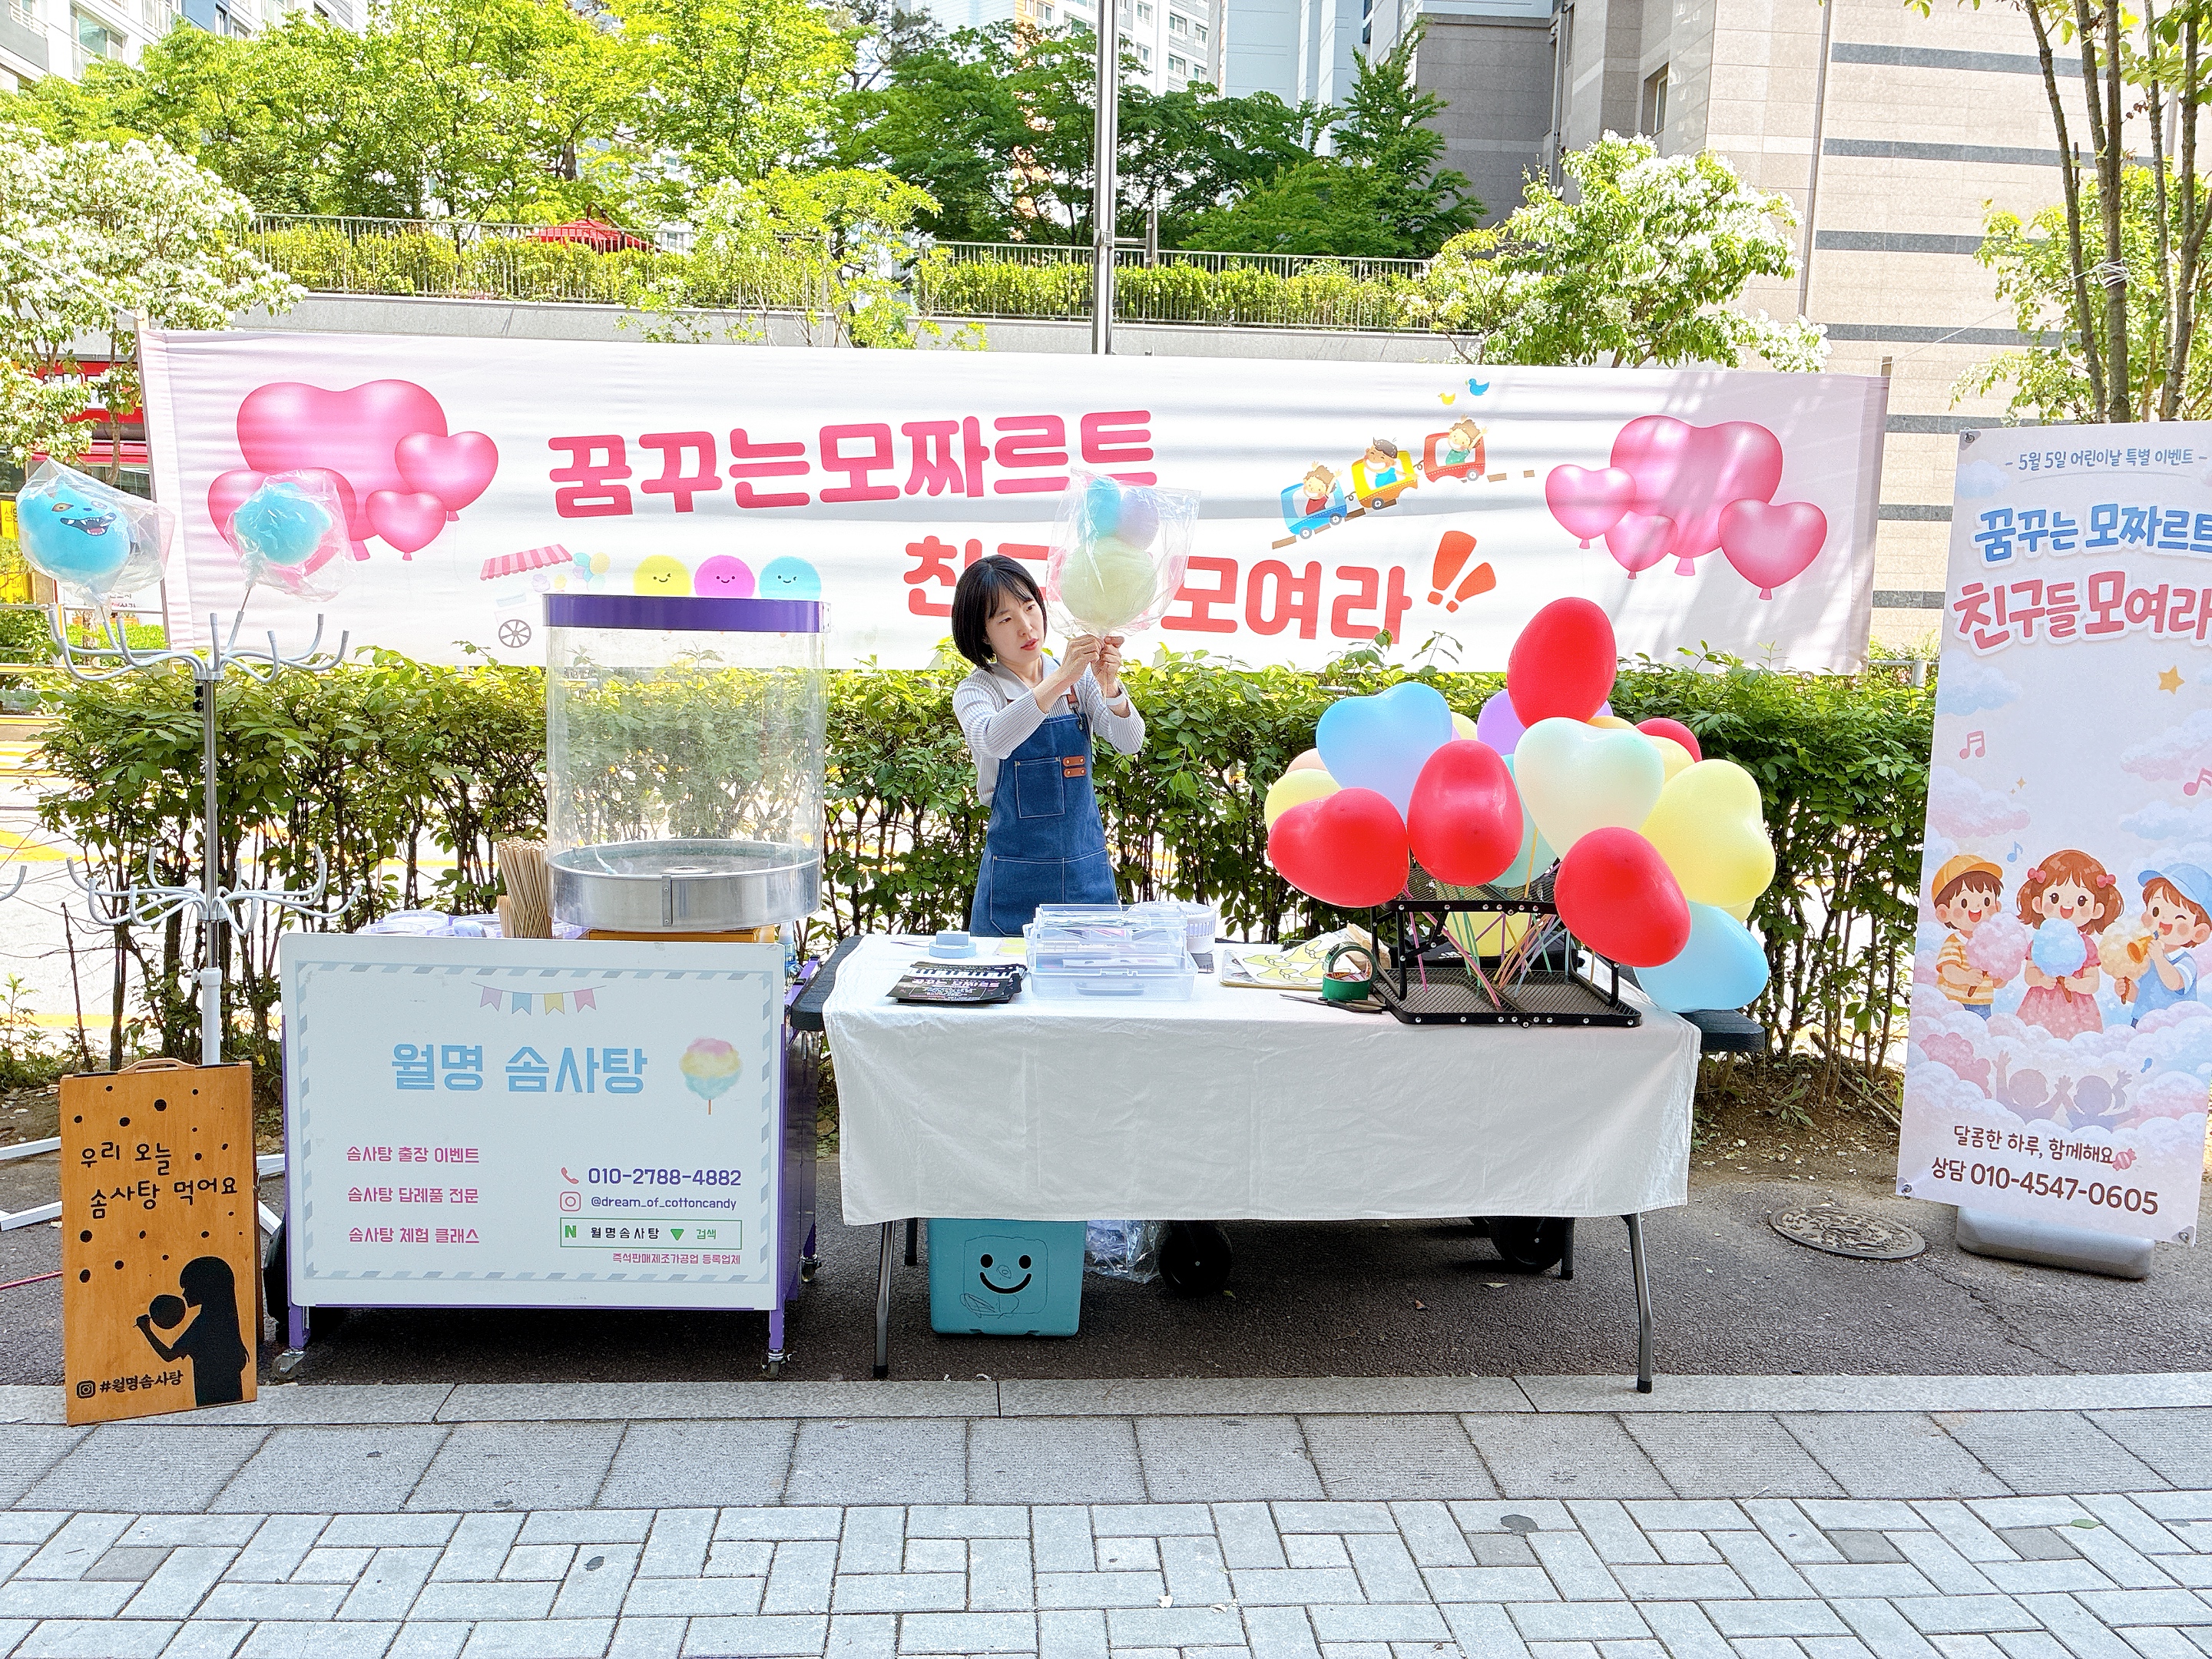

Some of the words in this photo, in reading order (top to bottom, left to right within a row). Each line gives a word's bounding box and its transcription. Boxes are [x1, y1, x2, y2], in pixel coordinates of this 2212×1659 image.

[2018, 452, 2041, 471] 5월
[2045, 452, 2066, 469] 5일
[2071, 449, 2122, 467] 어린이날
[2126, 449, 2150, 466] 특별
[2155, 449, 2193, 465] 이벤트
[1975, 508, 2078, 561] 꿈꾸는
[1954, 579, 2079, 649] 친구들
[392, 1045, 483, 1091] 월명
[505, 1047, 647, 1094] 솜사탕
[347, 1147, 392, 1161] 솜사탕
[399, 1147, 429, 1162] 출장
[435, 1148, 479, 1163] 이벤트
[1955, 1126, 2002, 1149] 달콤한
[2008, 1133, 2042, 1158] 하루,
[2049, 1138, 2114, 1164] 함께해요
[81, 1142, 120, 1167] 우리
[135, 1143, 171, 1176] 오늘
[589, 1168, 741, 1185] 010-2788-4882
[1932, 1157, 1966, 1181] 상담
[1971, 1163, 2157, 1214] 010-4547-0605
[91, 1181, 161, 1219] 솜사탕
[174, 1177, 237, 1205] 먹어요
[348, 1187, 392, 1202] 솜사탕
[399, 1188, 443, 1203] 답례품
[450, 1189, 478, 1203] 전문
[591, 1197, 737, 1210] @dream_of_cottoncandy
[349, 1227, 394, 1242] 솜사탕
[400, 1228, 428, 1243] 체험
[435, 1229, 479, 1243] 클래스
[697, 1230, 716, 1239] 검색
[613, 1253, 698, 1263] 즉석판매제조가공업
[703, 1255, 740, 1264] 등록업체
[100, 1370, 184, 1393] #월명솜사탕
